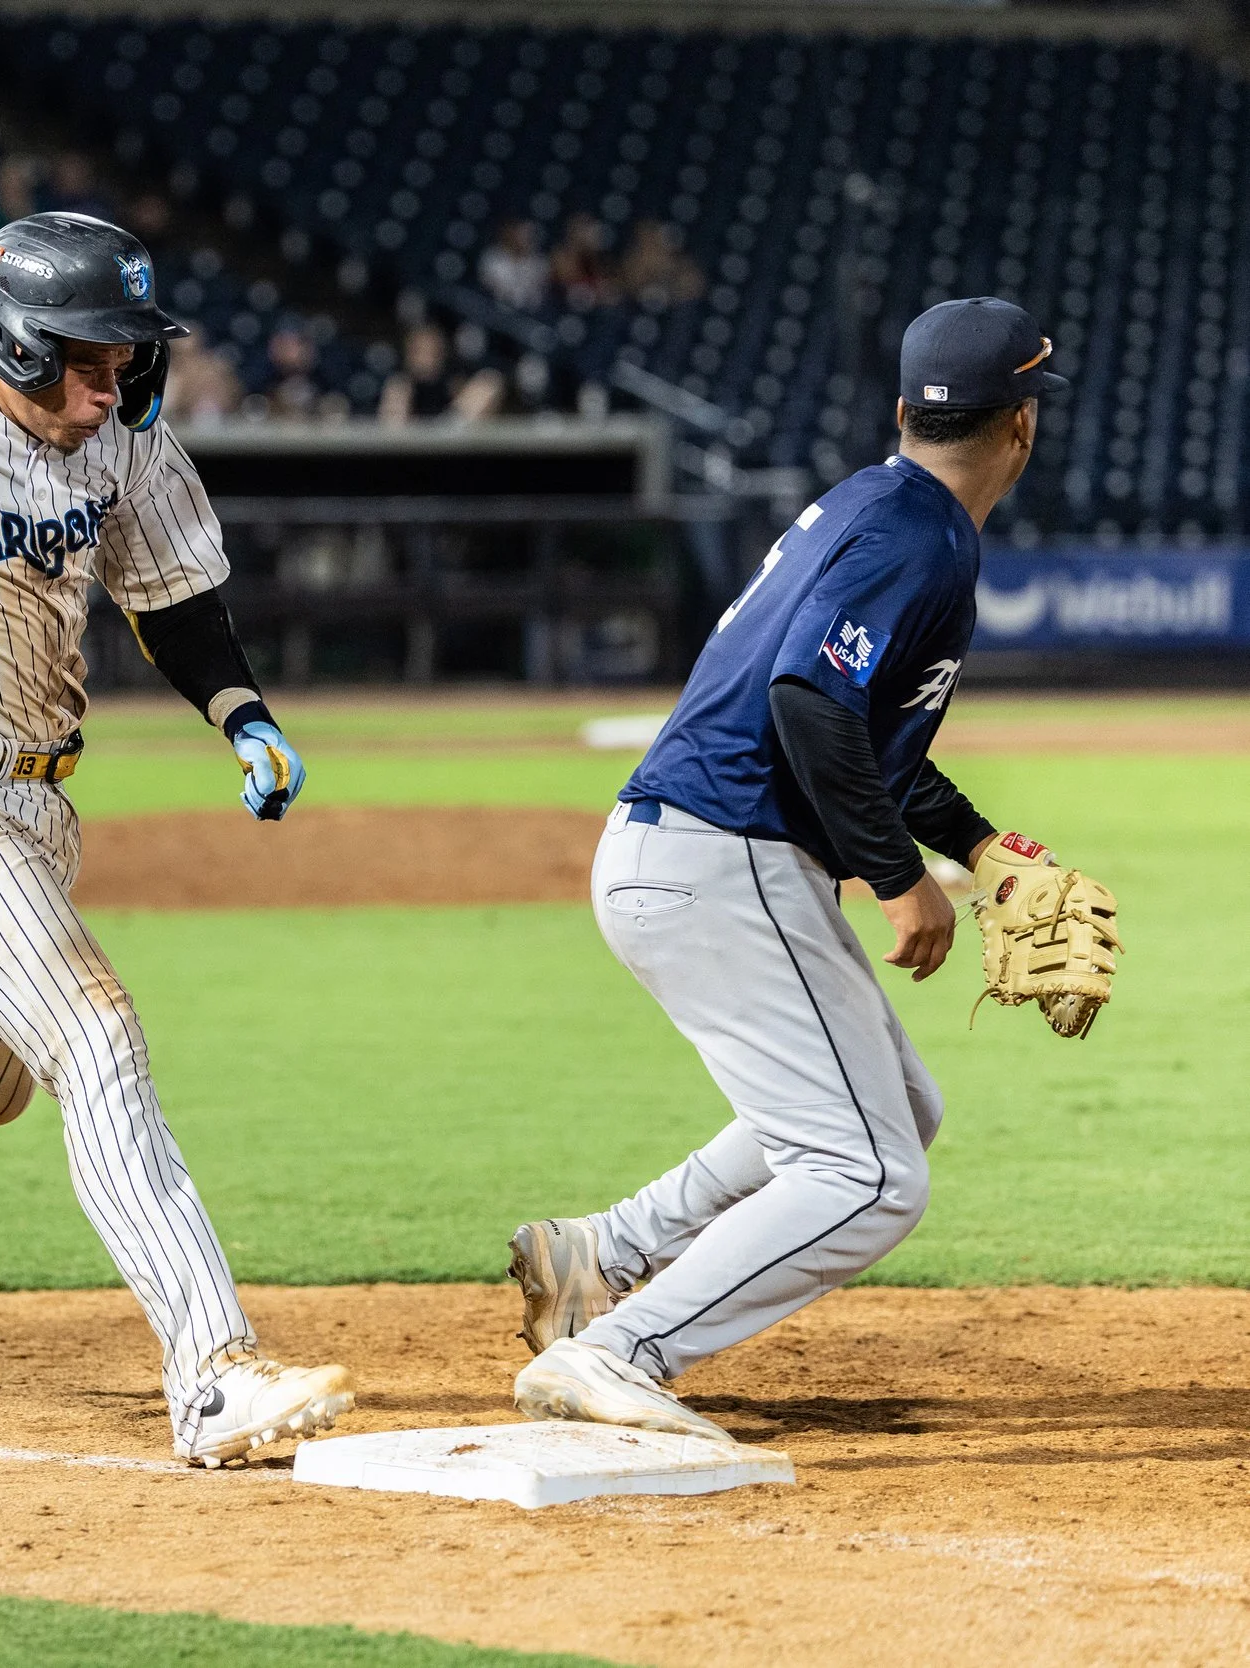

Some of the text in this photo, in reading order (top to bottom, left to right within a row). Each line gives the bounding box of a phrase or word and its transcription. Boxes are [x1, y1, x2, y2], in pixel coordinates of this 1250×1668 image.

[2, 251, 54, 279] STRAUSS
[832, 641, 862, 671] USAA
[13, 755, 36, 775] 13
